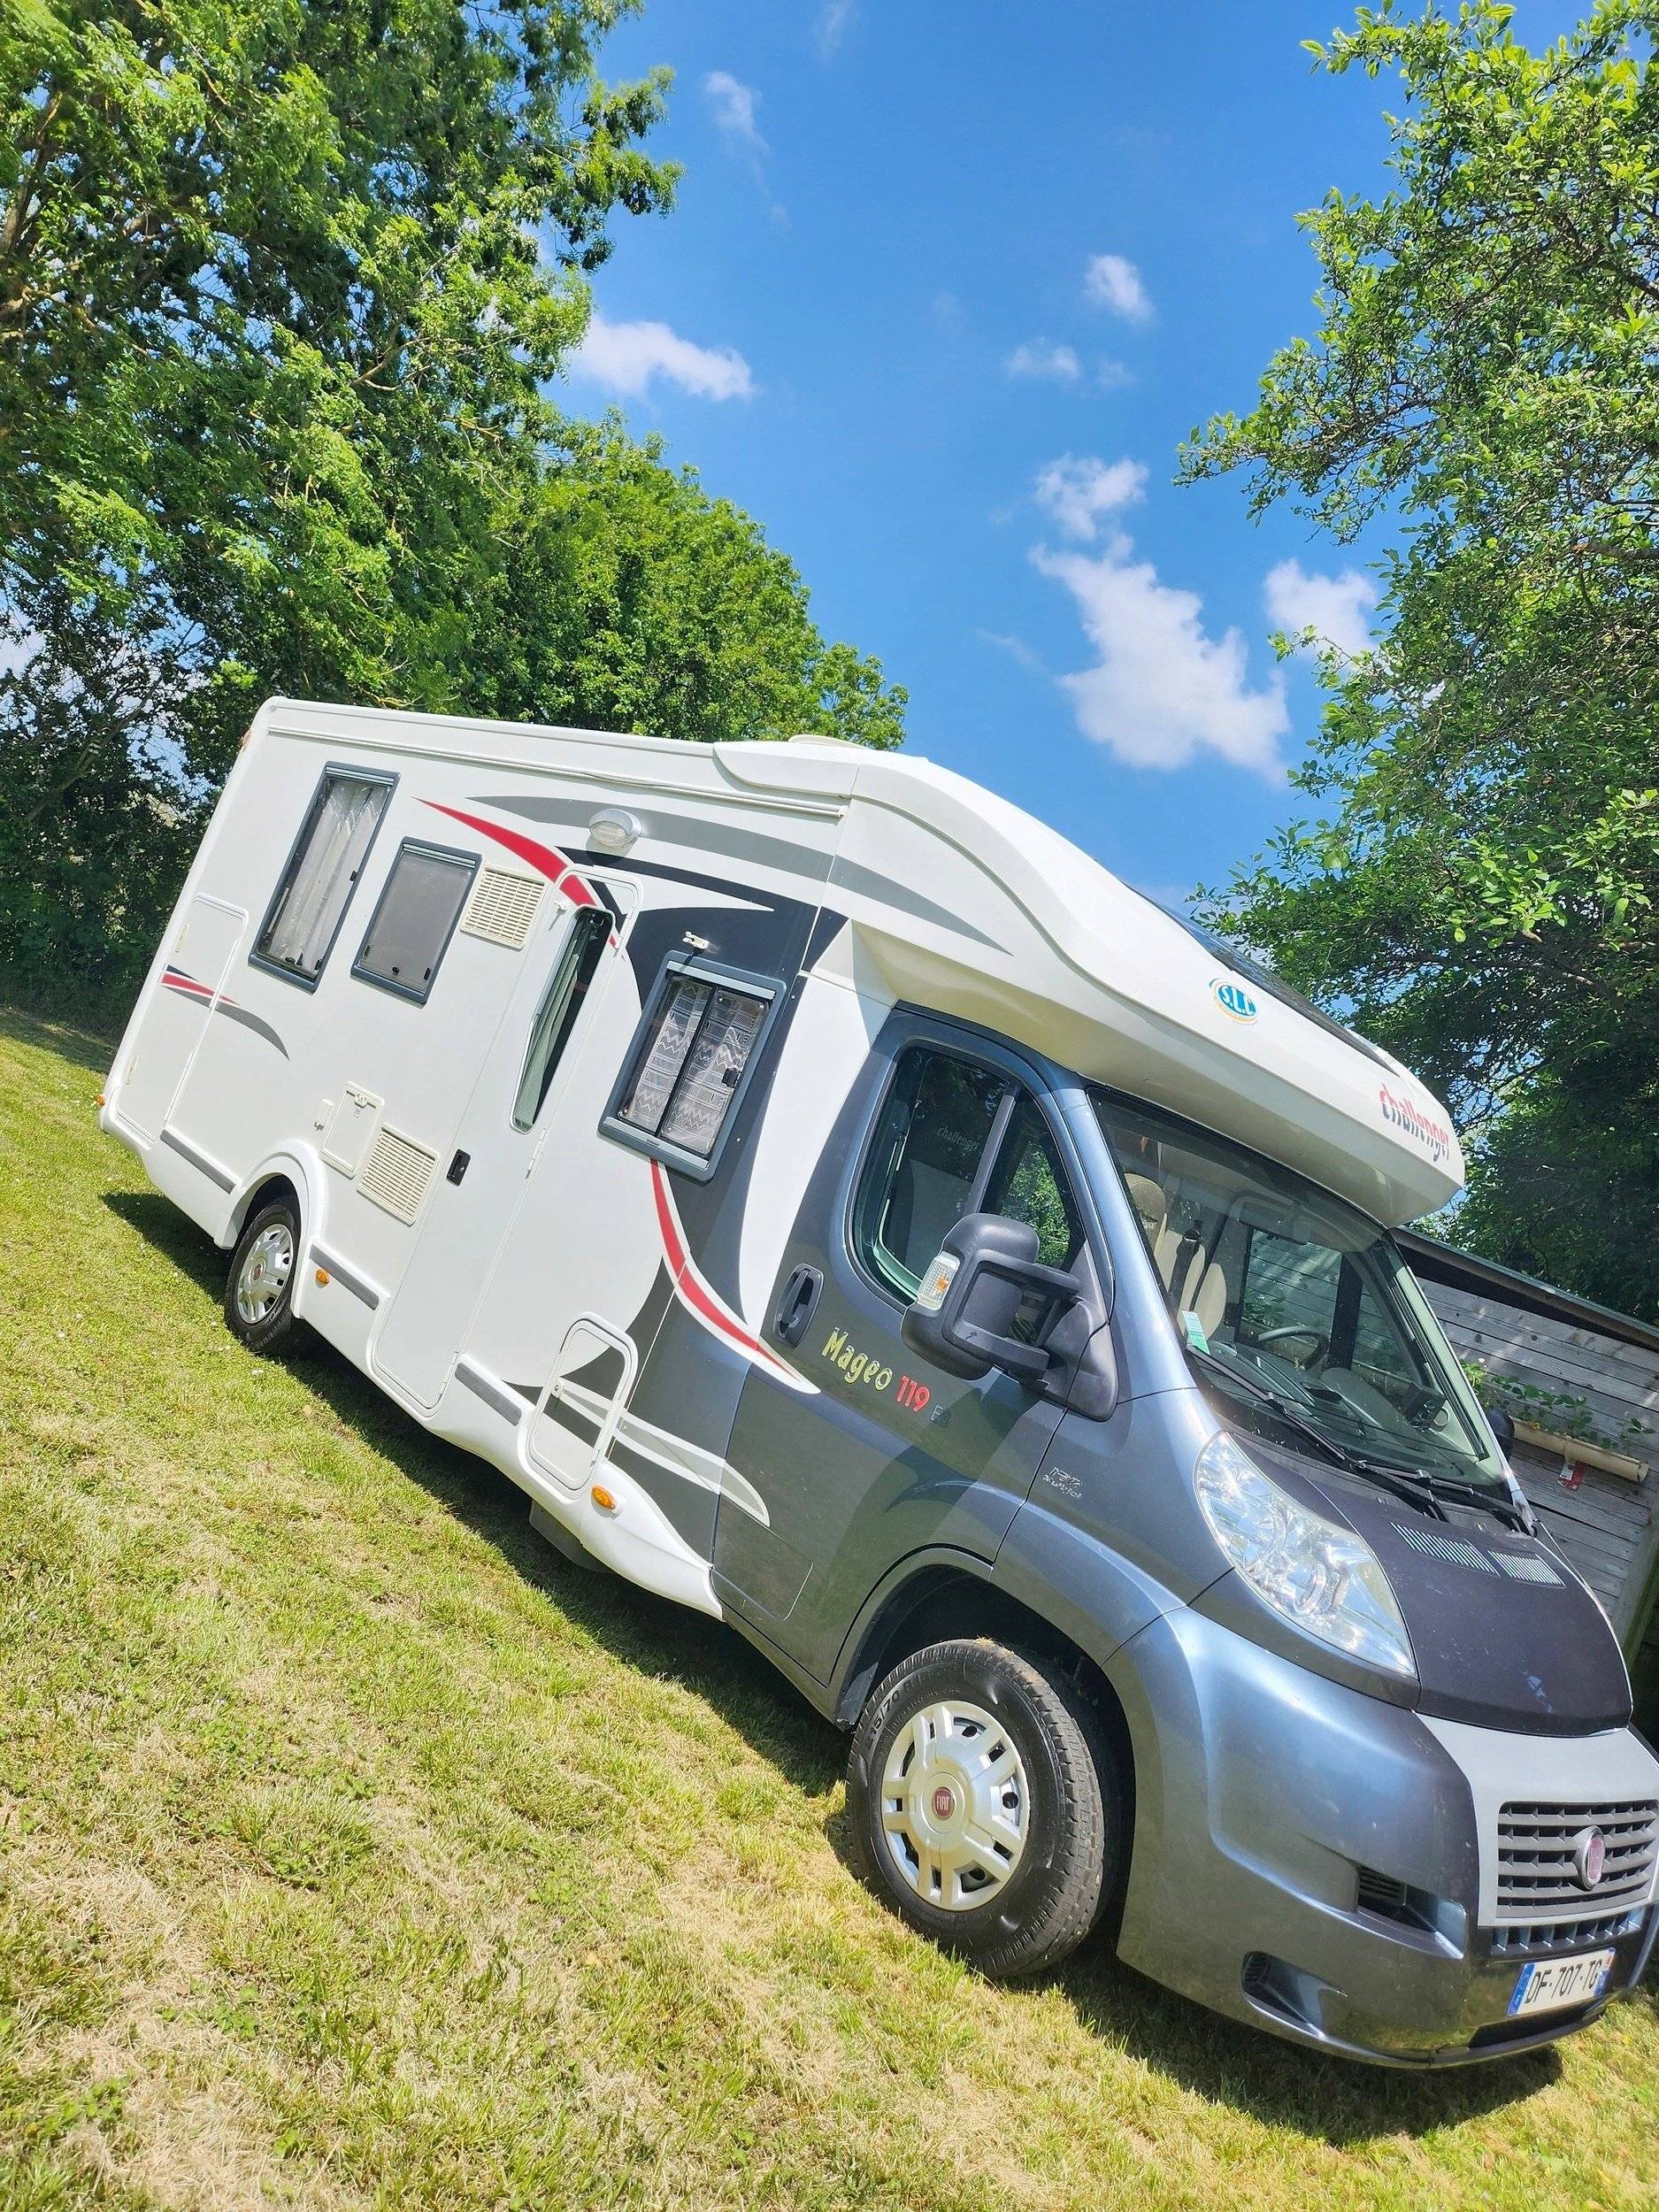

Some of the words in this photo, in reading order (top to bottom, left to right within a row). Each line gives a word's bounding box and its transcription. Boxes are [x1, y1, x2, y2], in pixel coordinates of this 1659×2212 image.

[821, 1326, 893, 1391] Mageo
[895, 1375, 931, 1412] 119
[936, 1795, 949, 1811] FIAT
